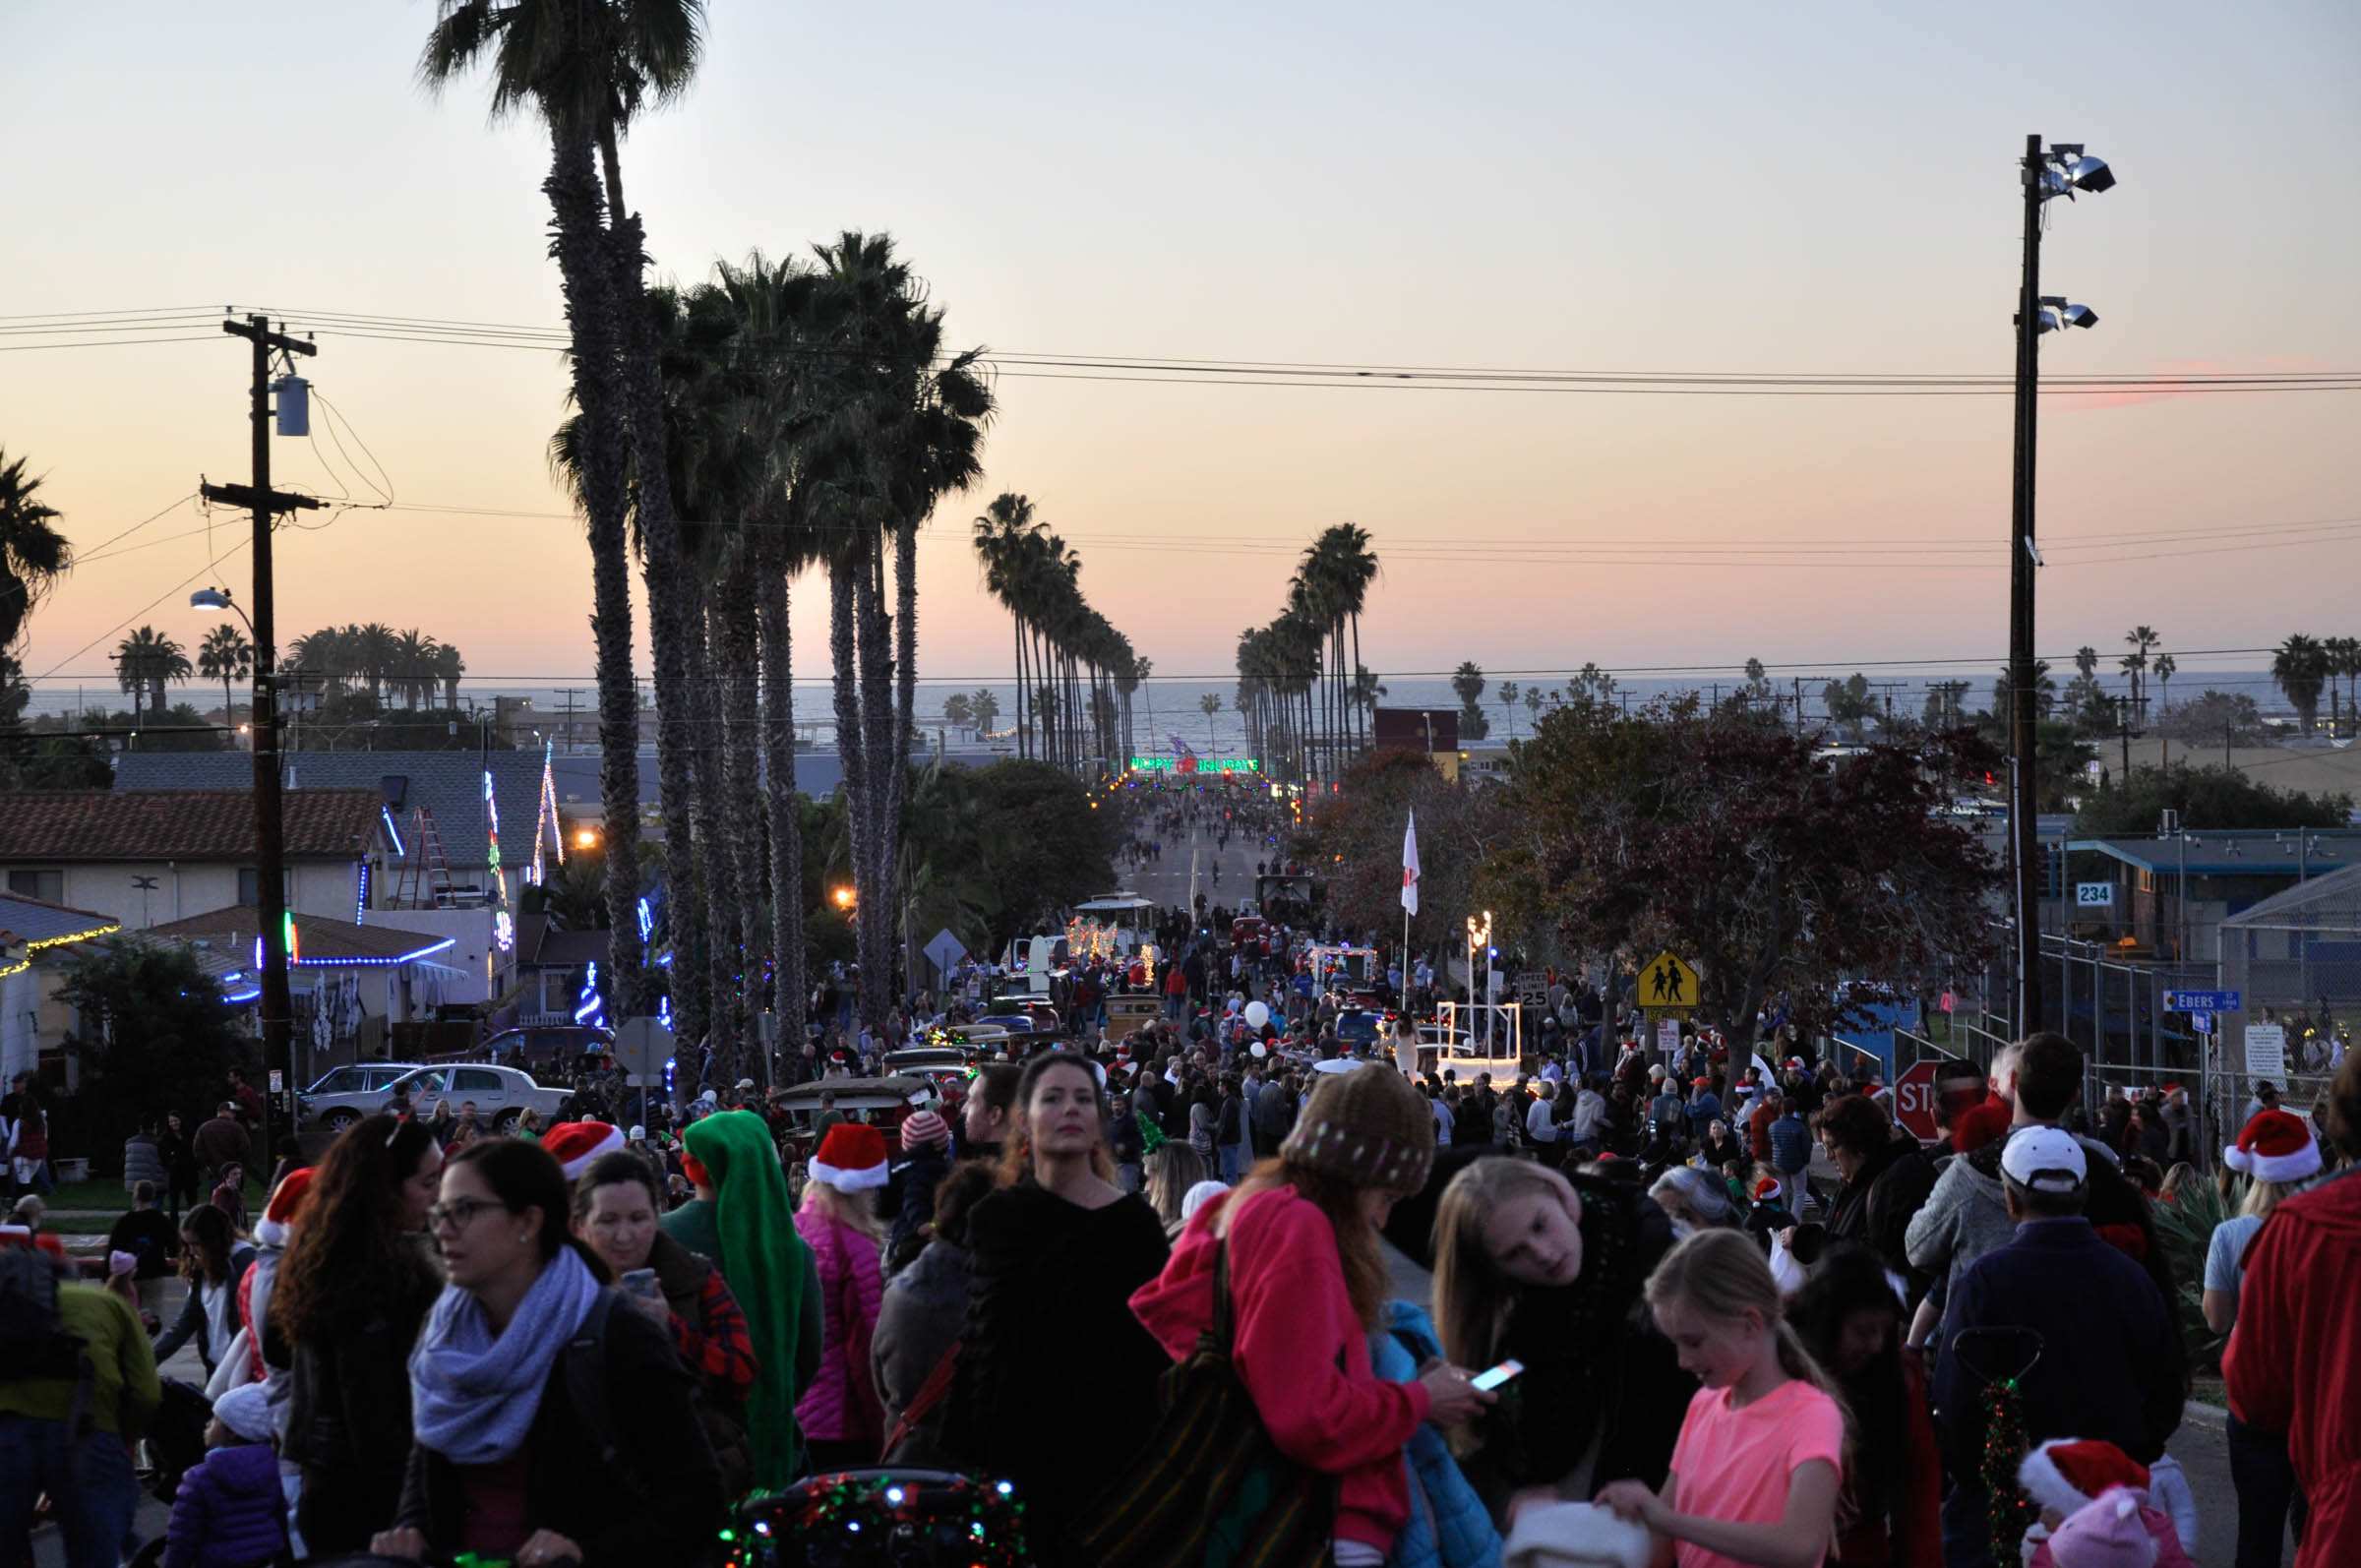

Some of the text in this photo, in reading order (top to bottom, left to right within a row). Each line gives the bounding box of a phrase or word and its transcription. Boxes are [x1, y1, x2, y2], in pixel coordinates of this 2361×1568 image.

[1130, 757, 1173, 771] HAPPY
[2081, 886, 2108, 901] 234
[1523, 992, 1546, 1005] 25
[2178, 994, 2214, 1008] EBERS
